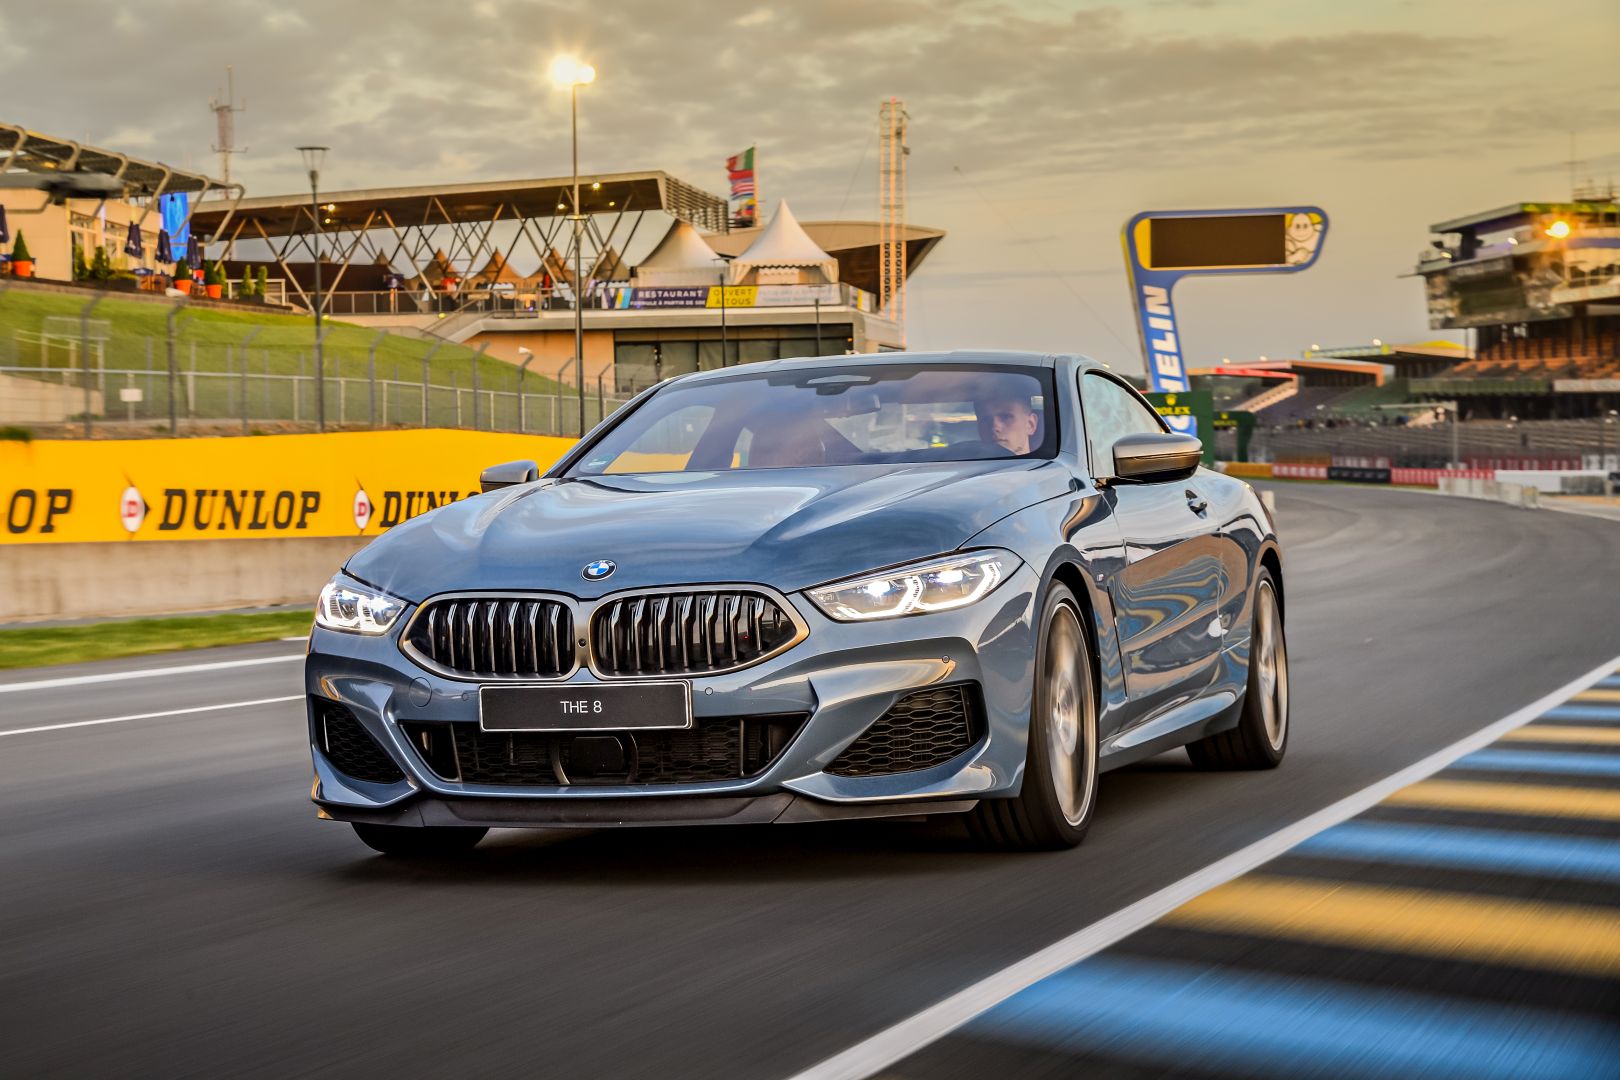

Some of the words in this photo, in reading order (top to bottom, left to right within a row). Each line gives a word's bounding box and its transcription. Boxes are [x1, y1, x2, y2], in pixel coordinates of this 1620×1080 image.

[638, 290, 703, 298] RESTAURANT
[725, 297, 752, 305] TOUS
[7, 488, 73, 534] OP
[157, 488, 321, 531] DUNLOP
[559, 700, 589, 714] THE
[593, 700, 602, 714] 8
